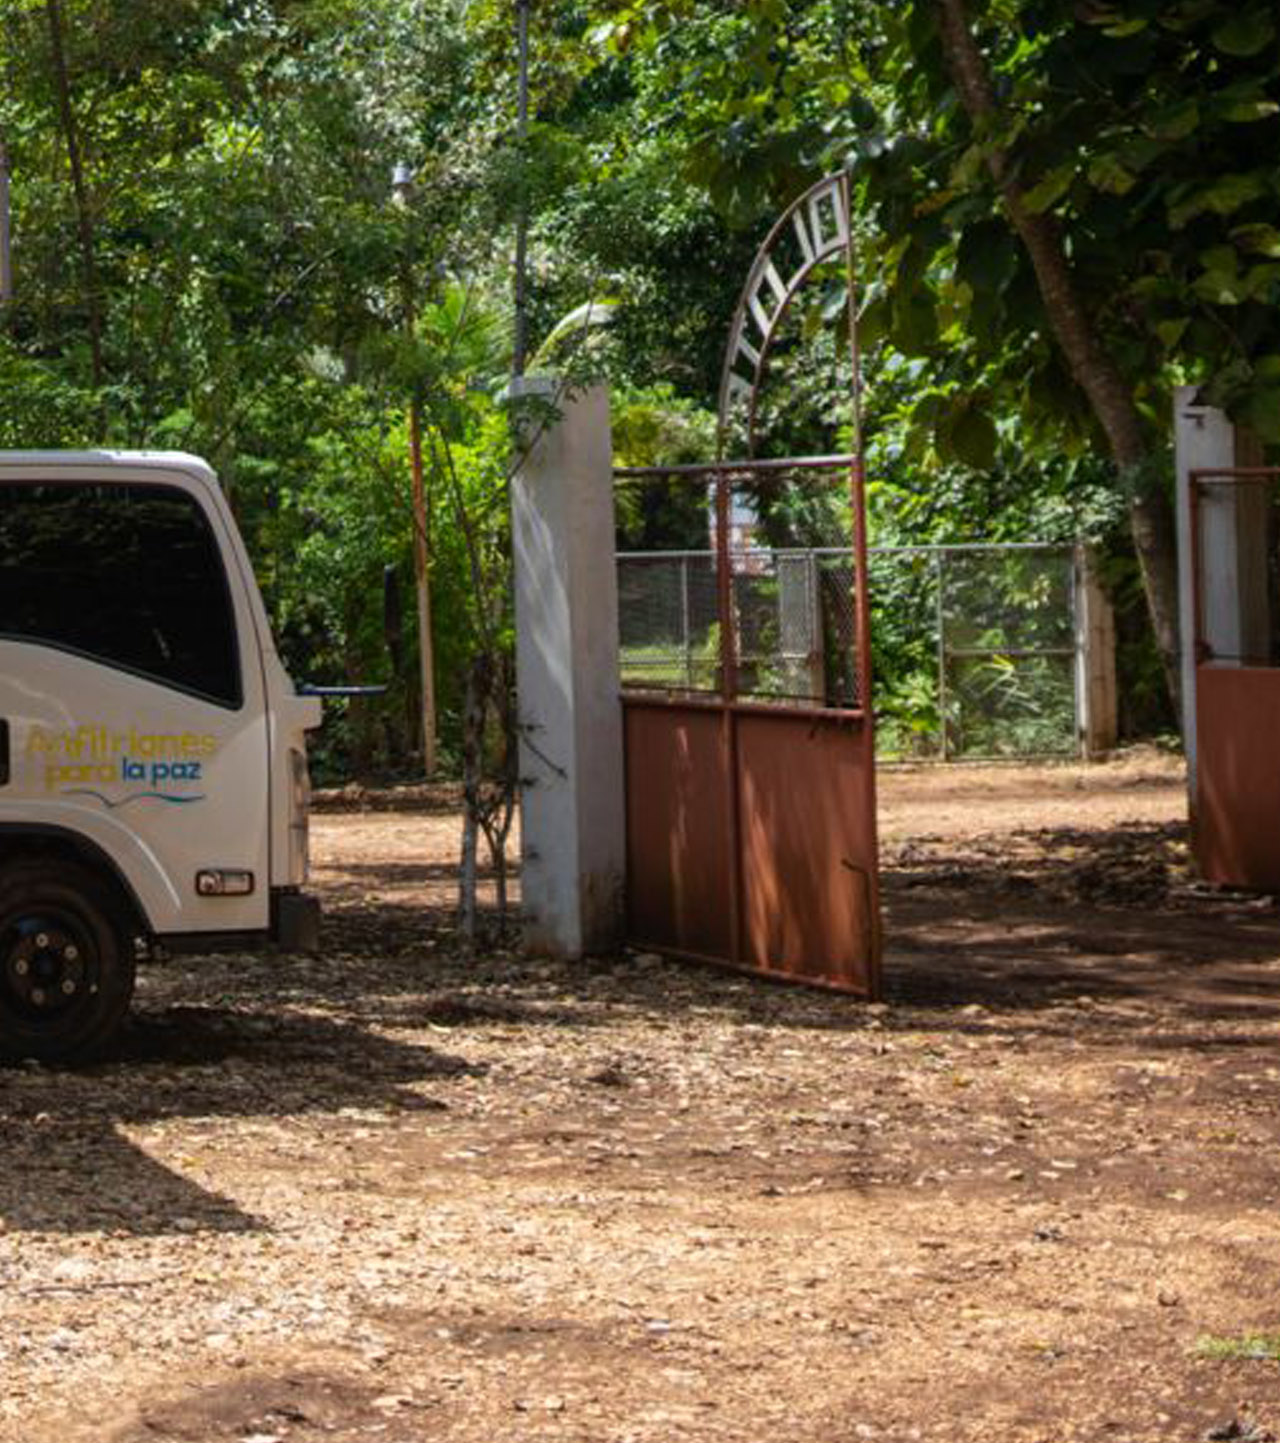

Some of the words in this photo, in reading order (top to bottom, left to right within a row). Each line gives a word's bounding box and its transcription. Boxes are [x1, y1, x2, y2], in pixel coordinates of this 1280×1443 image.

[46, 765, 117, 789] para
[122, 757, 145, 781] la
[152, 762, 202, 786] paz
